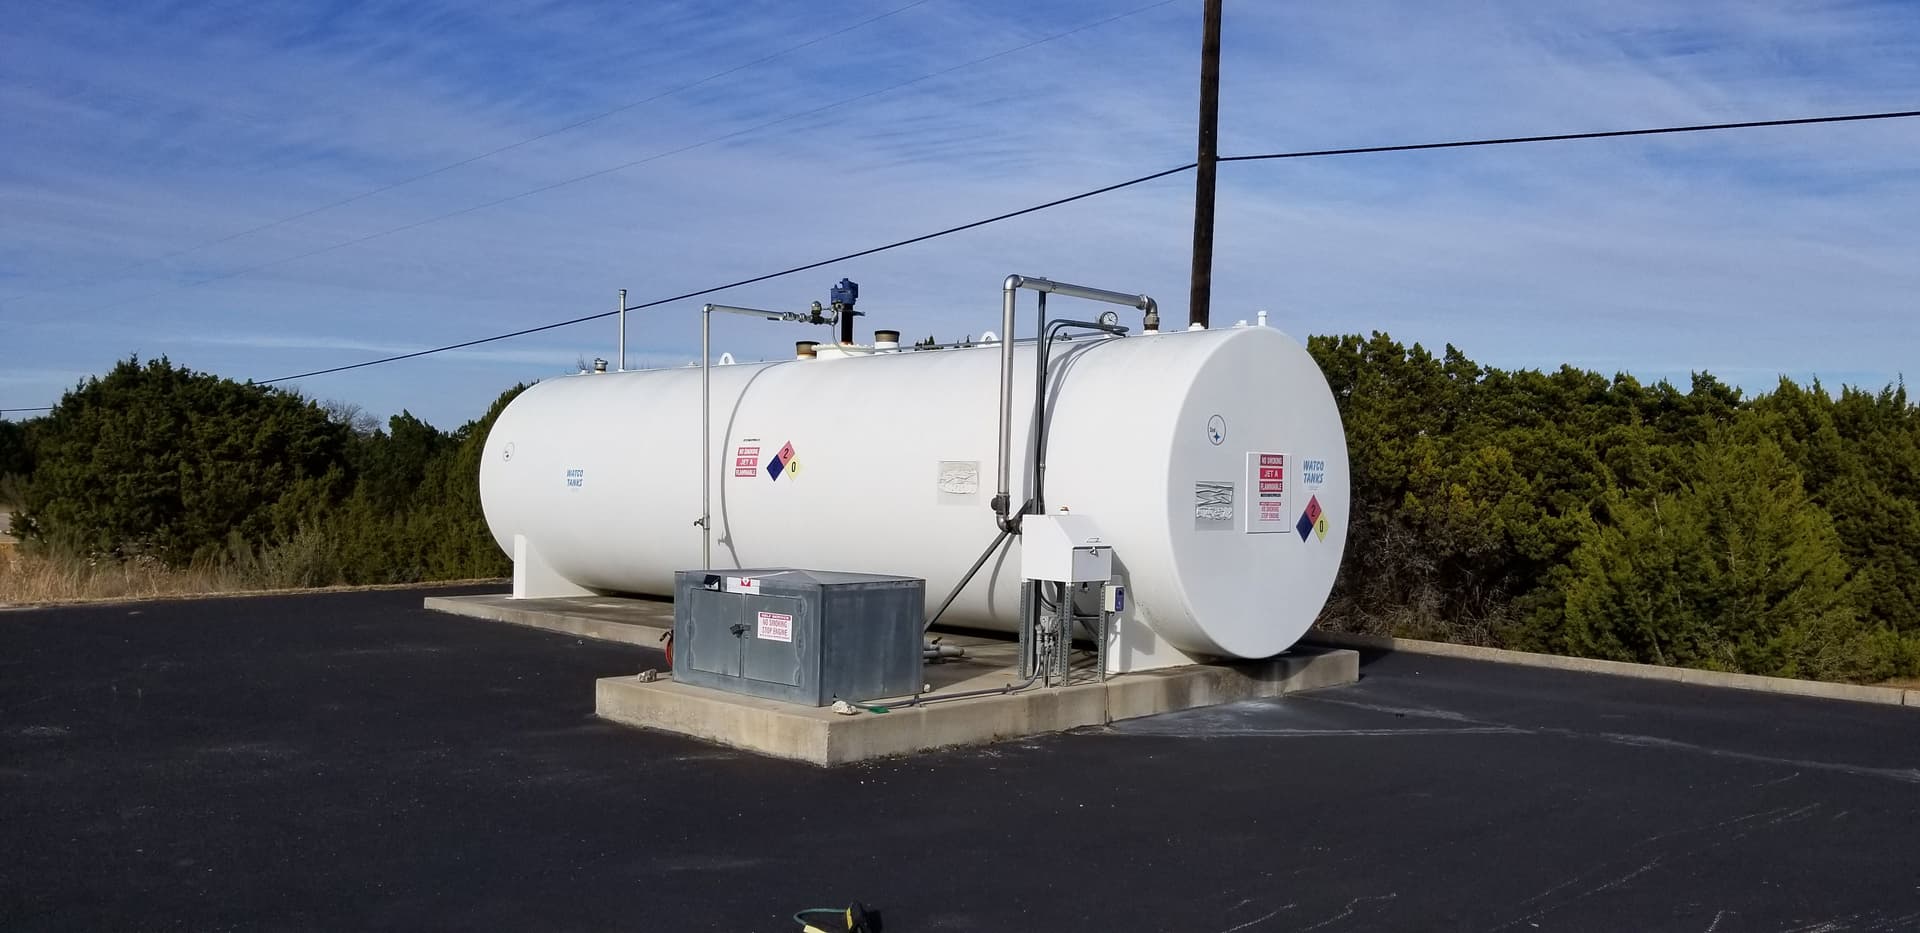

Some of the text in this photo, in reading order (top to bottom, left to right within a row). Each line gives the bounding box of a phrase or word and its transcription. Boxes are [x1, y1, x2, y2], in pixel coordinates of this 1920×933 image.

[783, 448, 789, 459] 2
[792, 462, 796, 472] 0
[1304, 460, 1324, 470] WATCO
[1274, 470, 1278, 478] A
[1304, 473, 1324, 483] TANKS
[1311, 504, 1316, 517] 2
[1320, 520, 1324, 532] 0
[769, 620, 787, 628] SMOKING
[773, 628, 788, 636] ENGINE
